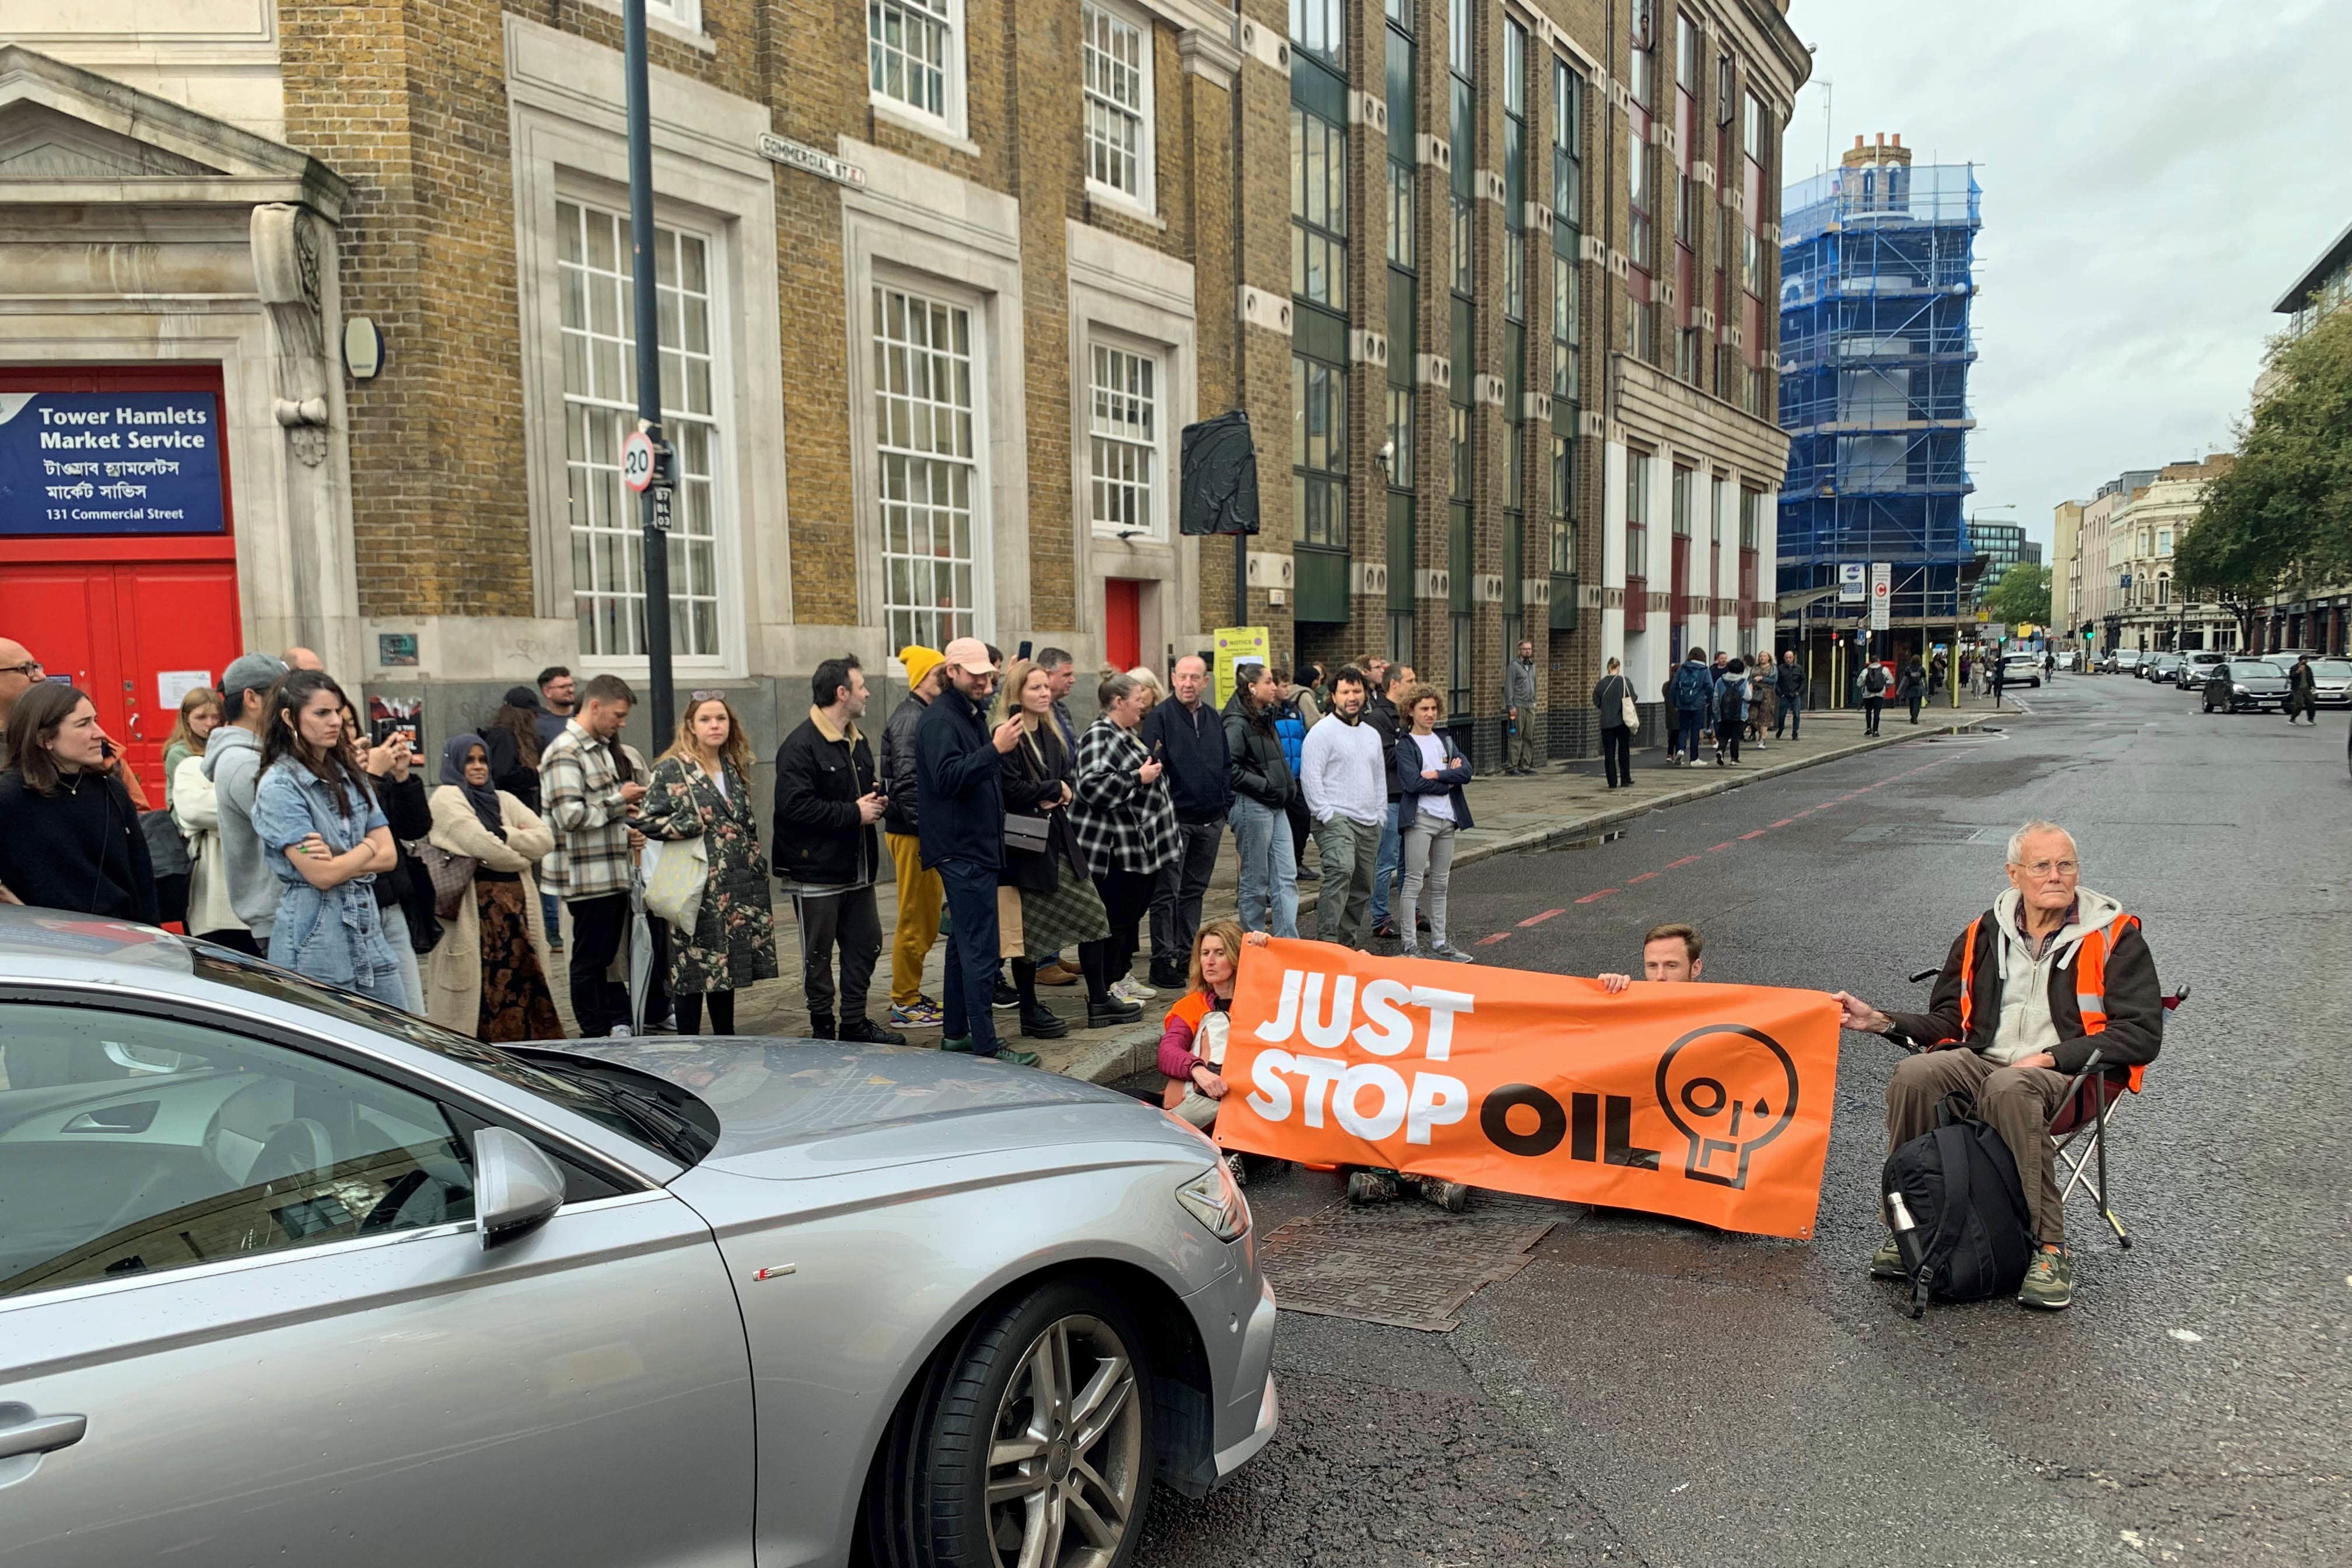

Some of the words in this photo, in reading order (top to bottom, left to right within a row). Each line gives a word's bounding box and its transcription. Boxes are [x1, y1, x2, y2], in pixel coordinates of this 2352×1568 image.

[764, 138, 830, 173] COMMERCIAL
[834, 163, 847, 178] ST
[38, 408, 110, 425] Tower
[116, 407, 207, 425] Hamlets
[40, 431, 121, 449] Market
[128, 430, 205, 449] Service
[625, 450, 648, 474] 20
[46, 509, 67, 520] 131
[71, 508, 145, 520] Commercial
[147, 508, 184, 520] Street
[1254, 969, 1475, 1062] JUST
[1245, 1048, 1468, 1145] STOP
[1480, 1083, 1660, 1171] OIL
